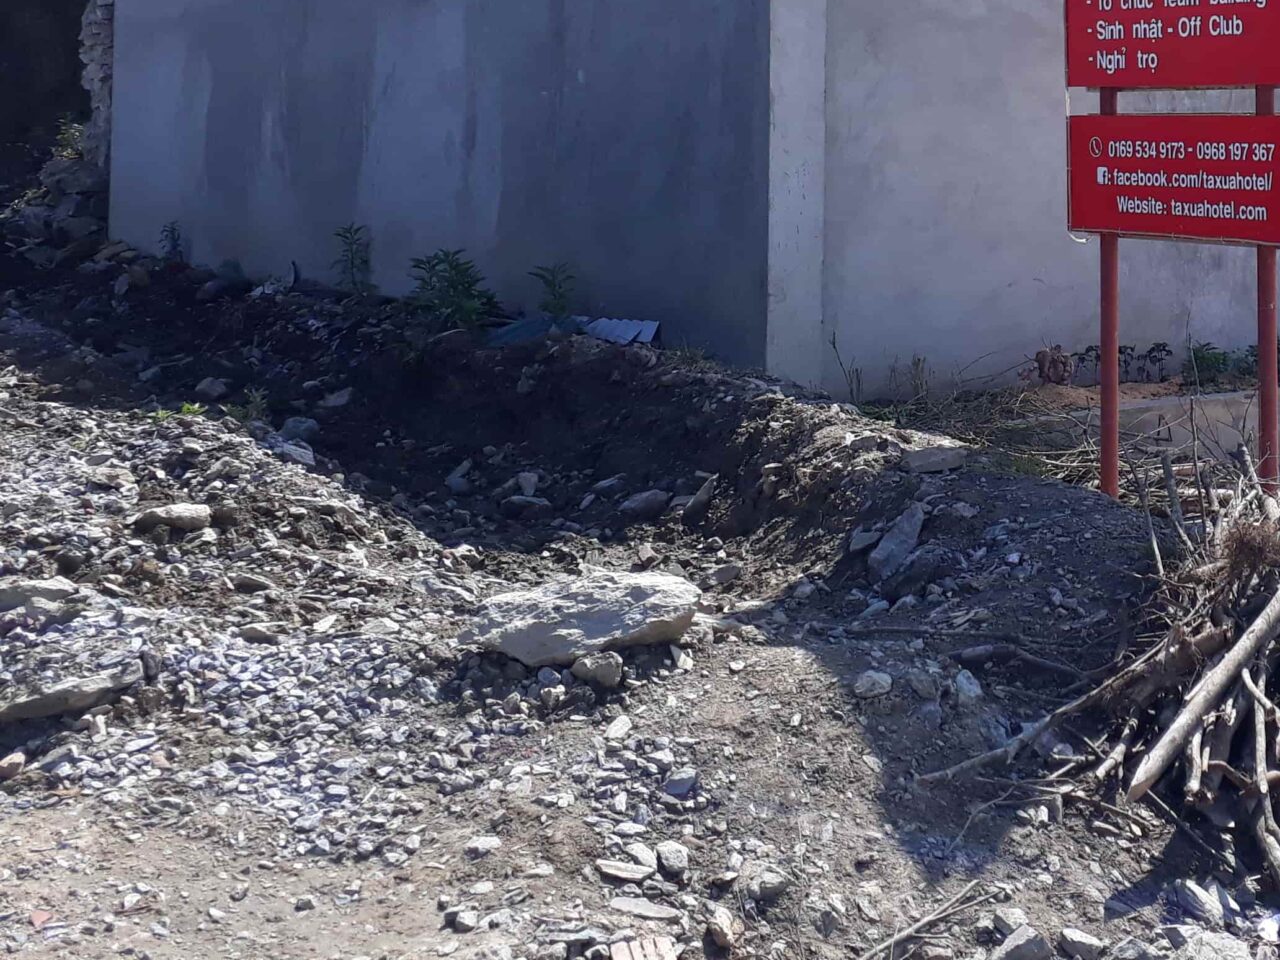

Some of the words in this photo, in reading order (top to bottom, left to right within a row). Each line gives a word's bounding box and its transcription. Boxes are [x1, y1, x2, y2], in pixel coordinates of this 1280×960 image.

[1132, 18, 1163, 43] nhật
[1178, 16, 1201, 38] Off
[1208, 14, 1243, 36] Club
[1137, 50, 1158, 73] trọ
[1108, 140, 1133, 158] 0169
[1135, 141, 1157, 159] 534
[1159, 141, 1185, 159] 9173
[1196, 141, 1226, 160] 0968
[1229, 142, 1249, 161] 197
[1252, 143, 1275, 162] 367
[1116, 195, 1167, 215] Website:
